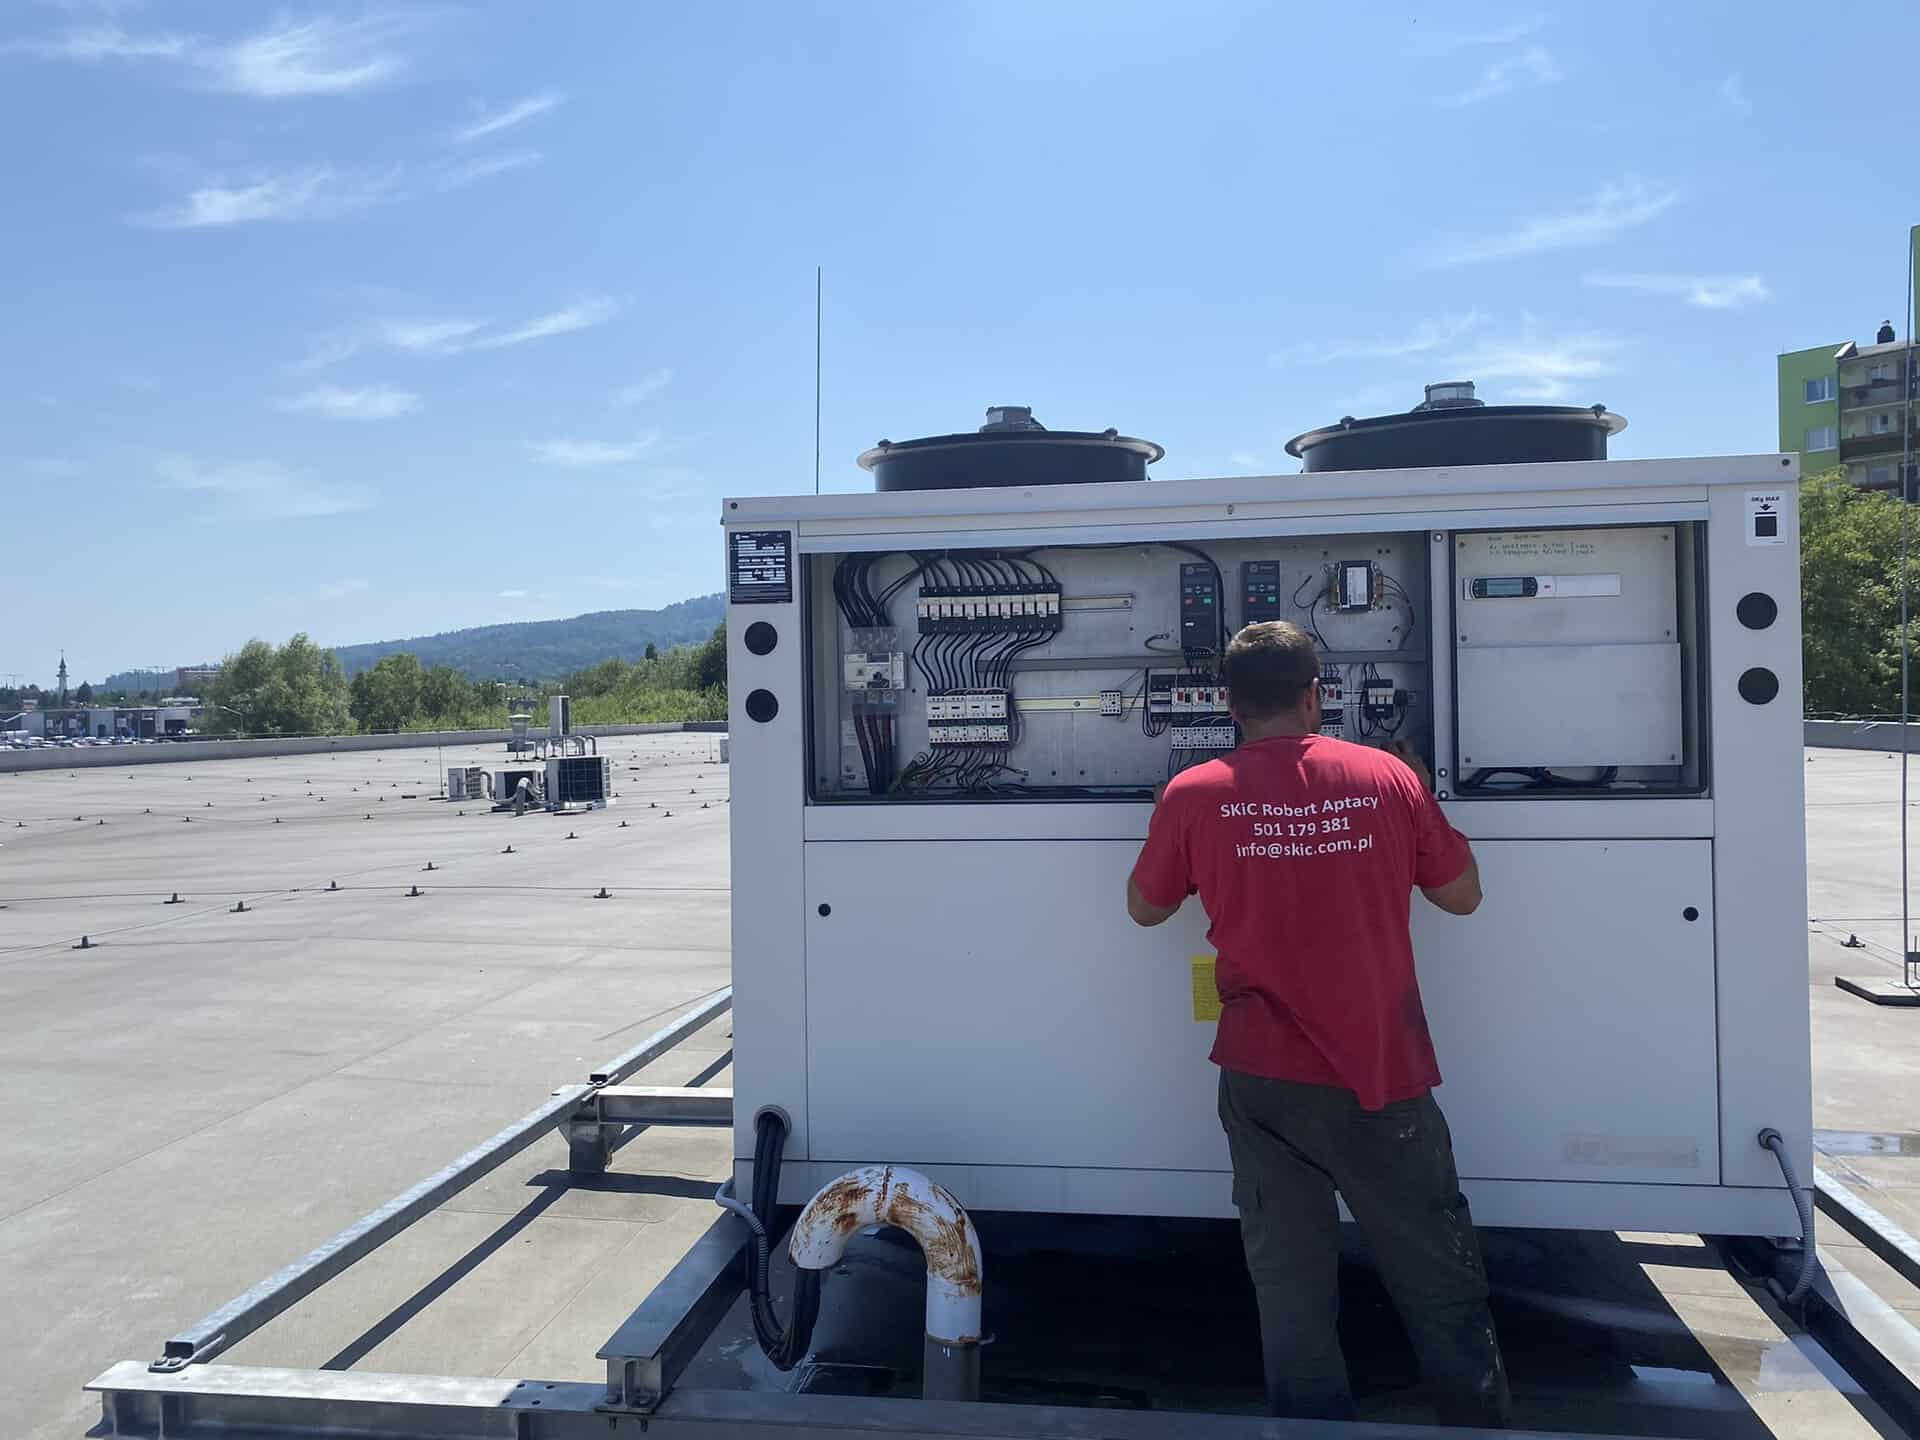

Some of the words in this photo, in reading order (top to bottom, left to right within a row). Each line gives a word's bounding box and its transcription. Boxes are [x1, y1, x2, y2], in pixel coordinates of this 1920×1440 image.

[1220, 803, 1257, 818] SKiC
[1262, 802, 1318, 817] Robert
[1321, 796, 1379, 813] Aptacy
[1253, 822, 1283, 836] 501
[1287, 822, 1316, 837] 179
[1320, 816, 1351, 833] 381
[1235, 834, 1373, 858] info@skic.com.pl
